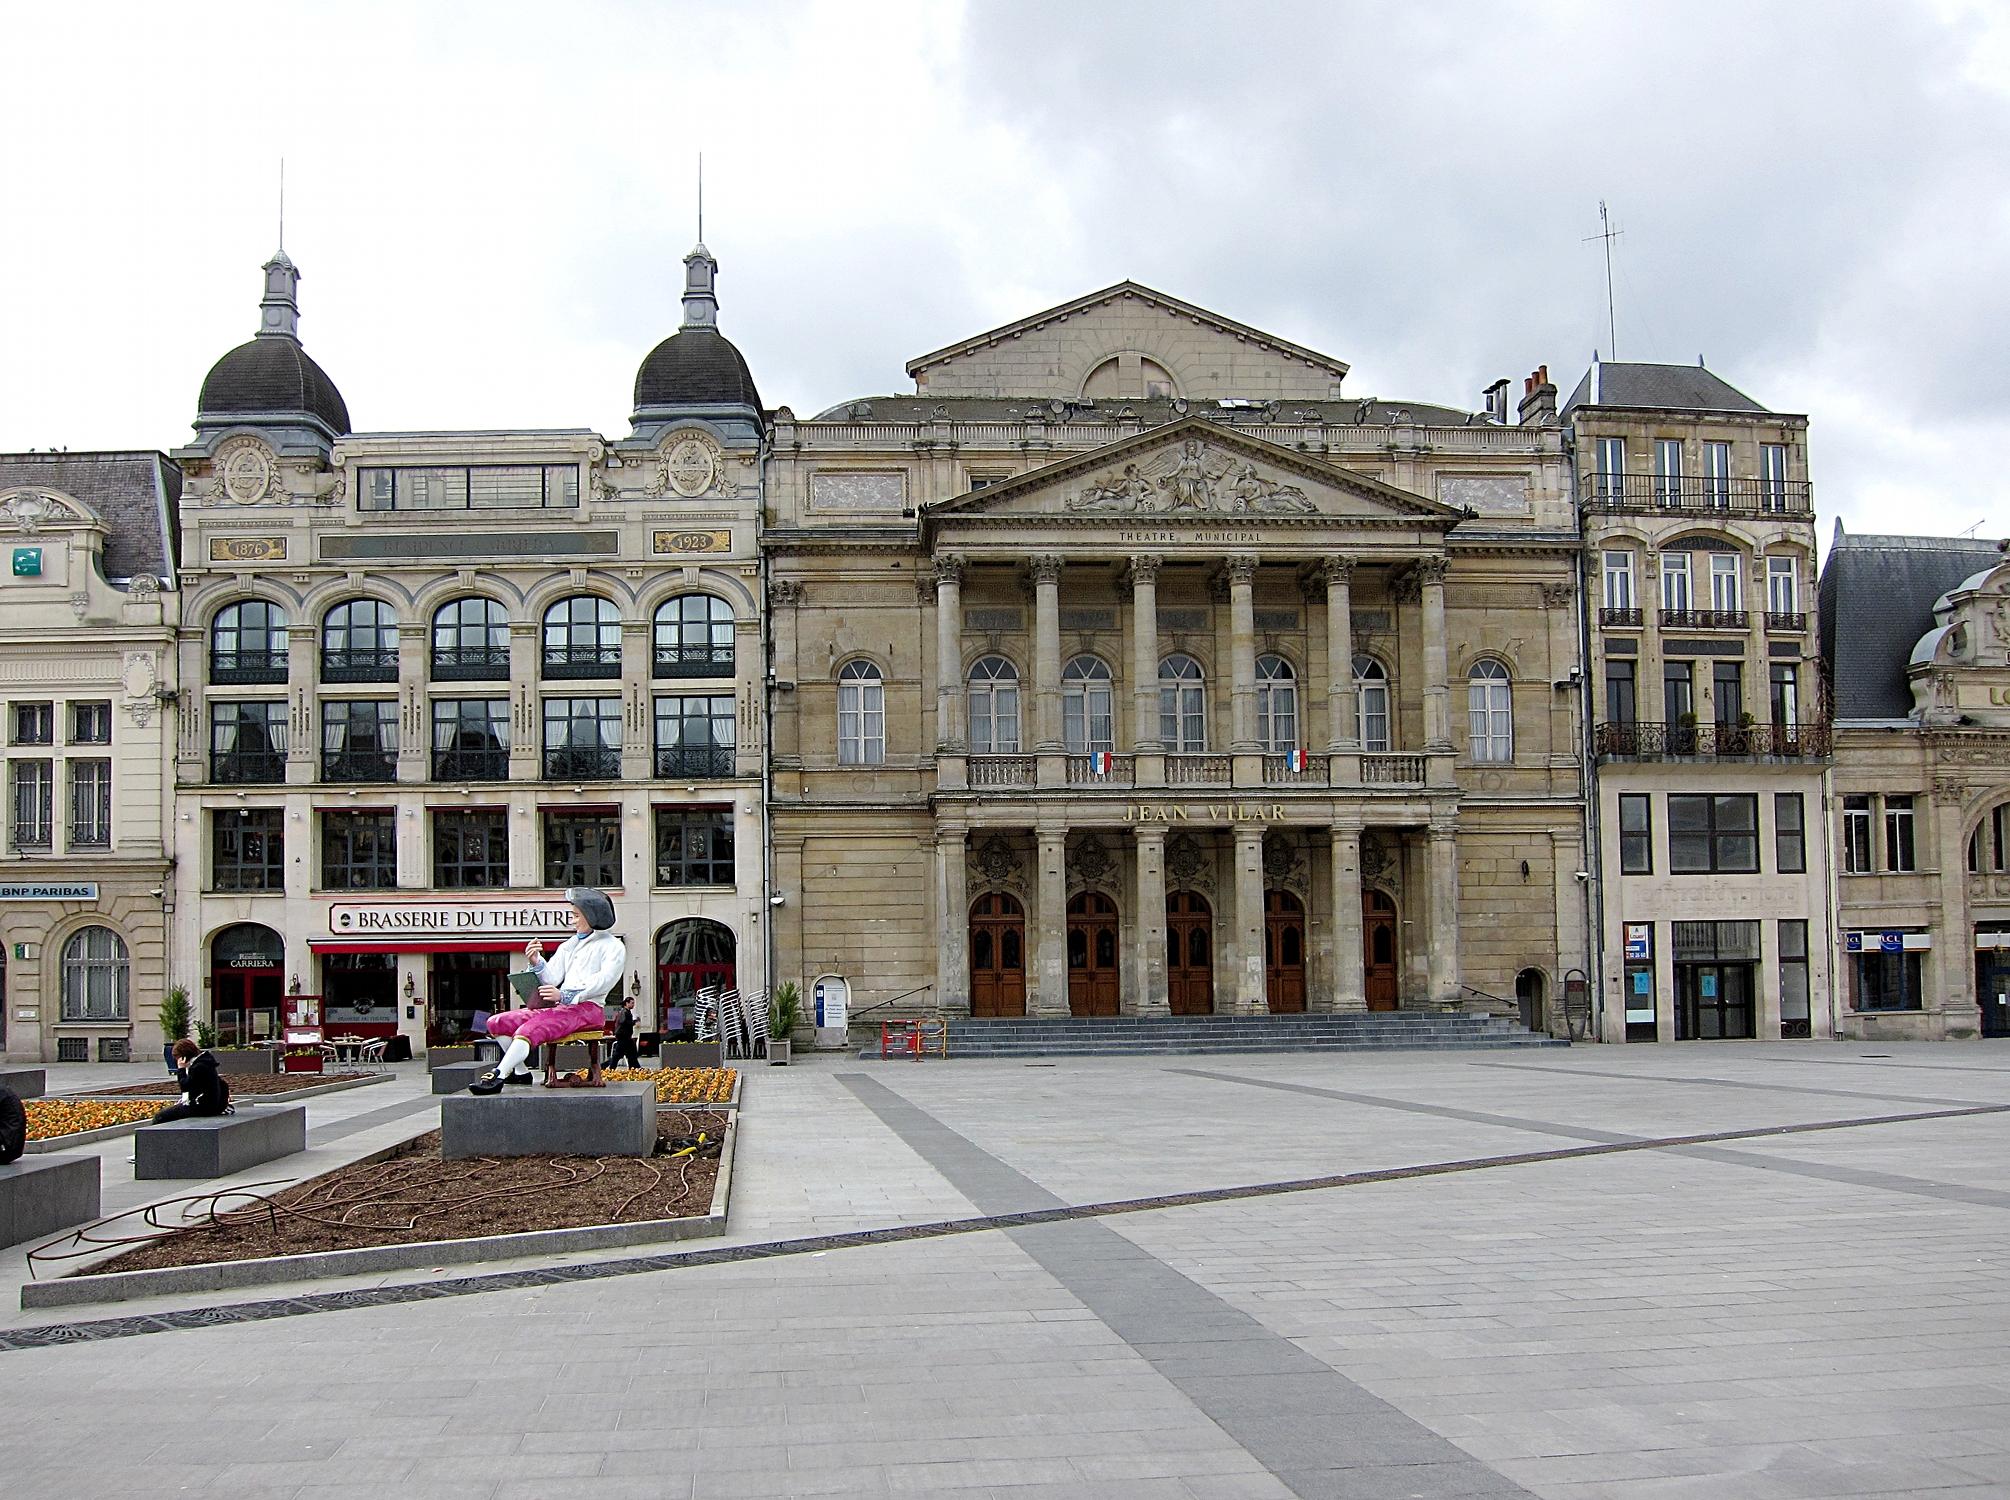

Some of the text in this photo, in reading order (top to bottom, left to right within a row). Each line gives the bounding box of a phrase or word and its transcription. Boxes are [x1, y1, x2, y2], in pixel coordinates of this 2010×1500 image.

[1120, 532, 1262, 541] THEATRE MUNICIPAL
[677, 536, 707, 549] 1923
[235, 543, 263, 556] 1876
[1122, 804, 1285, 821] JEAN VILAR
[1, 887, 89, 896] BNP PARIBAS
[358, 908, 577, 929] BRASSERIE DU THÉÂTRE
[1846, 936, 1860, 944] LCL
[1880, 933, 1902, 944] LCL
[230, 960, 274, 968] CARRIERA
